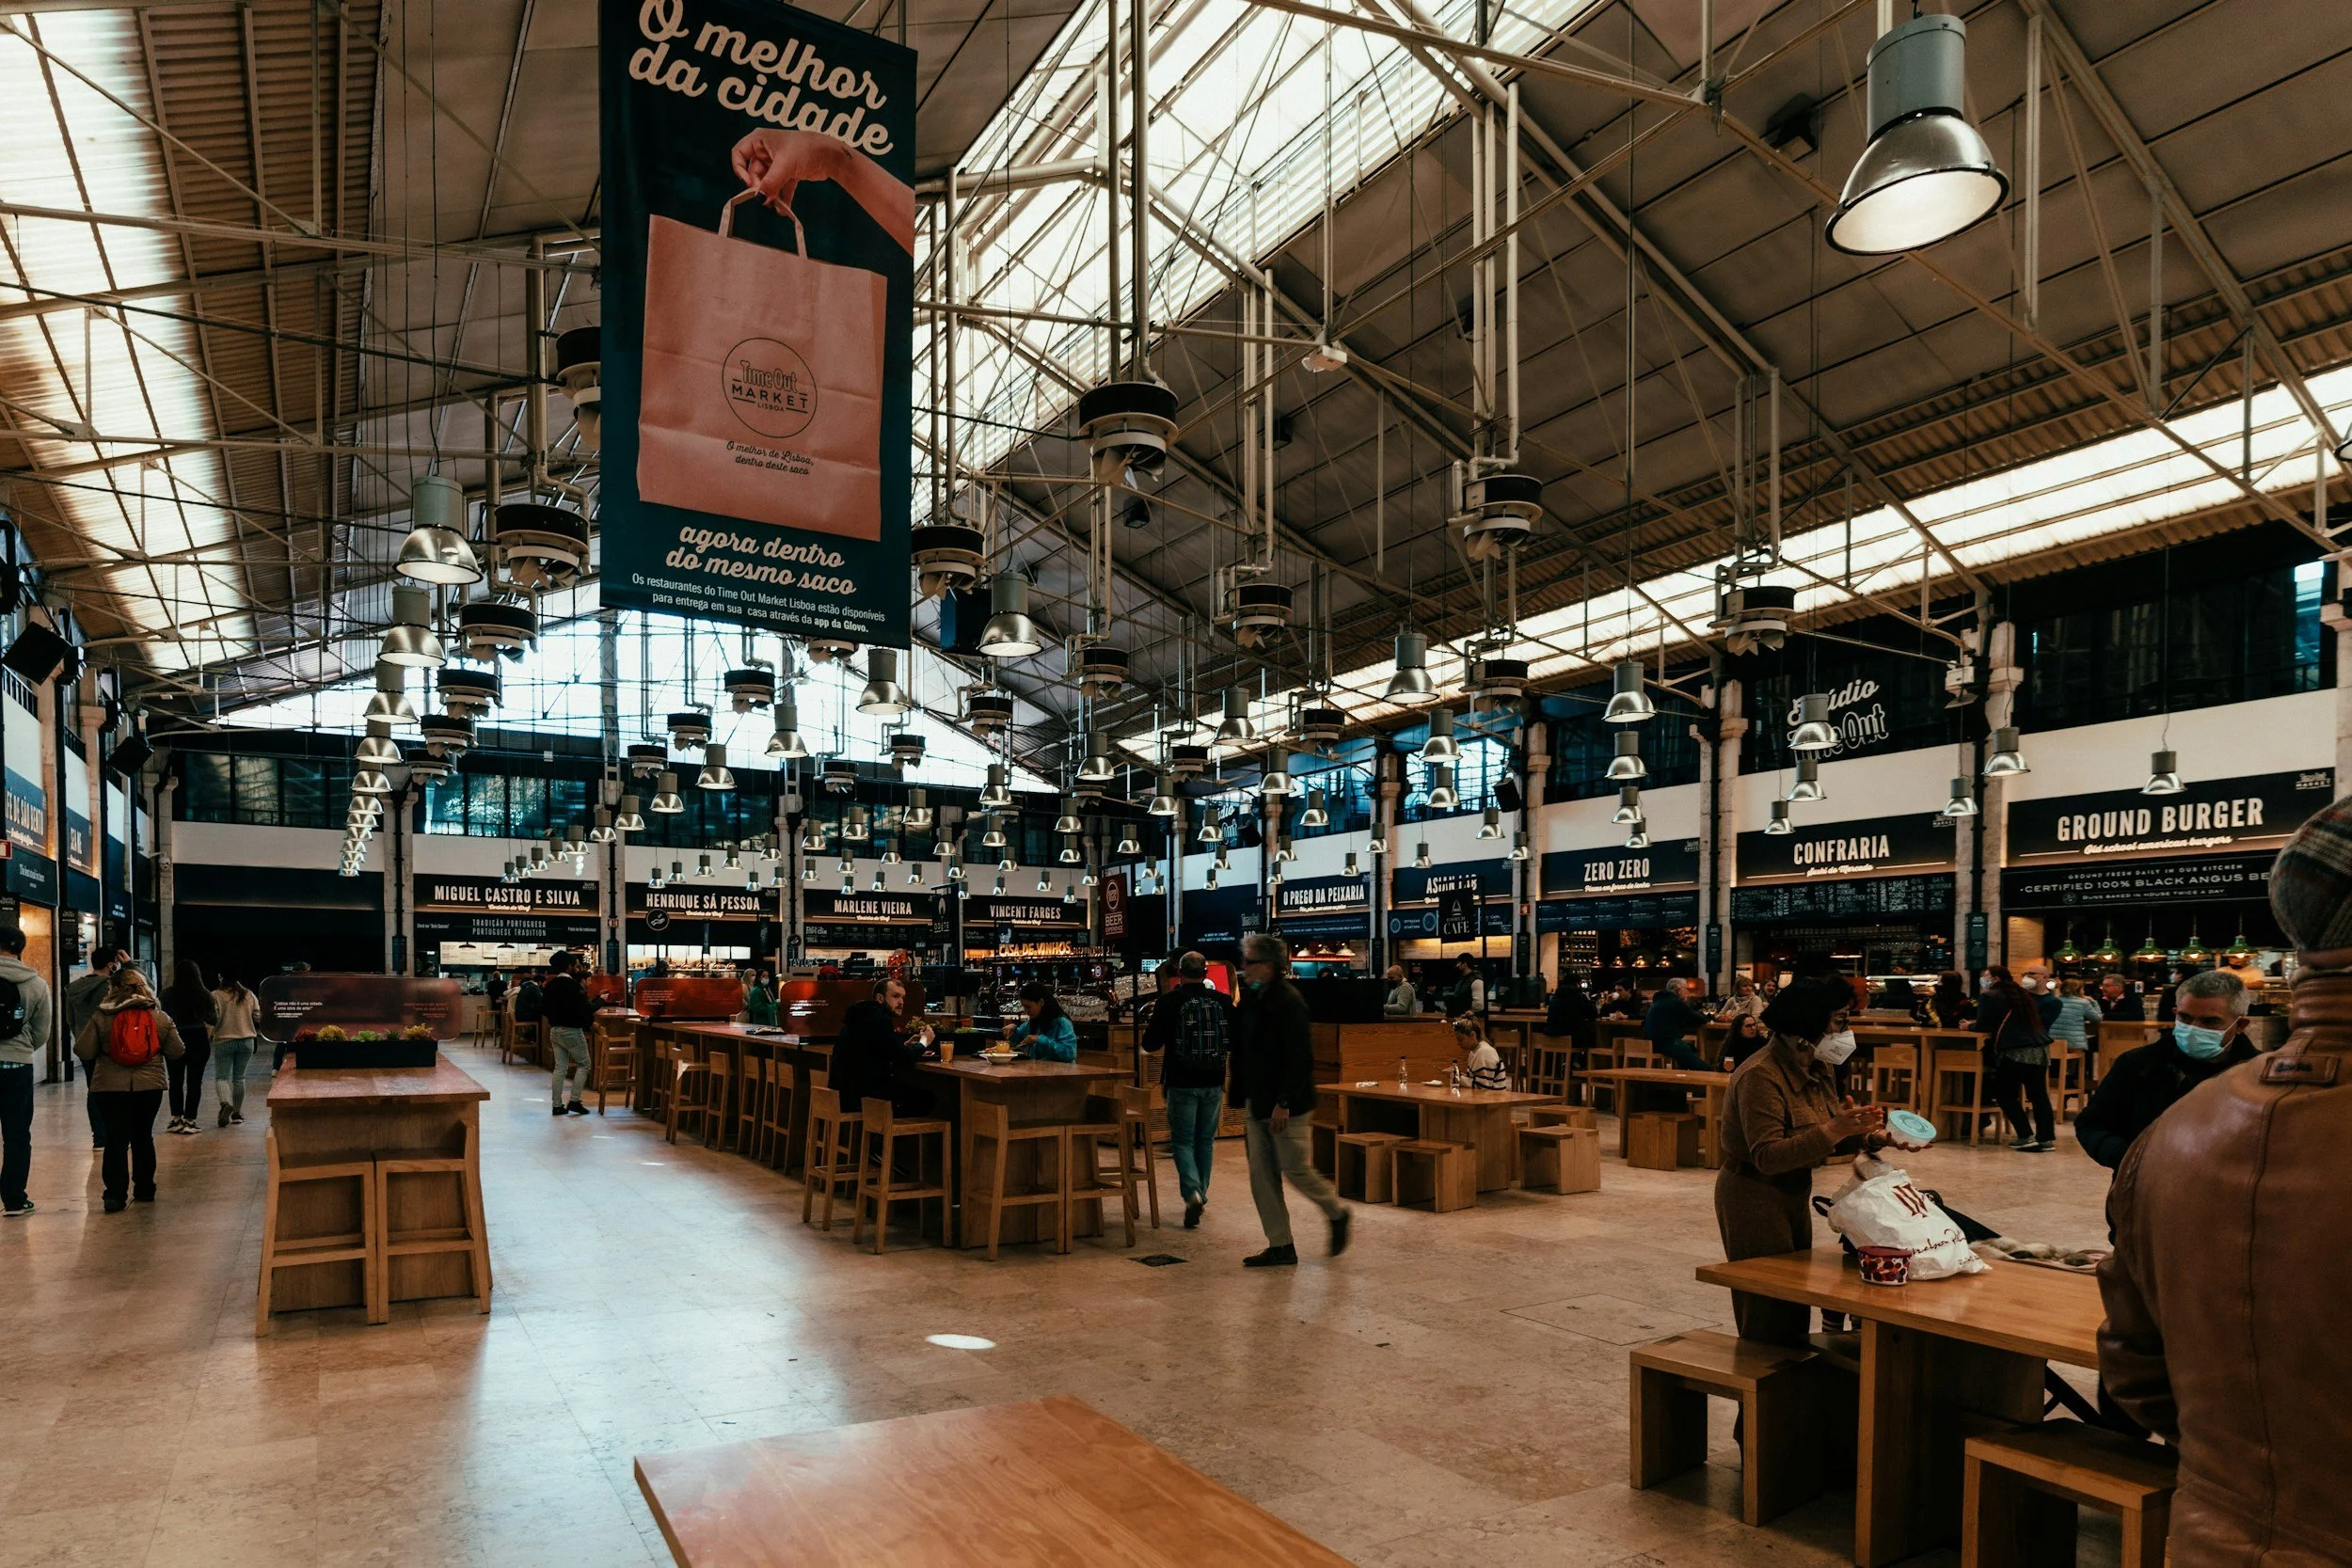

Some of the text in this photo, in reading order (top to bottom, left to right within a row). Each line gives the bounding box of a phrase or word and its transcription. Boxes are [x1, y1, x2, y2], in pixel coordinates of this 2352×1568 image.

[639, 0, 887, 110] O melhor
[628, 42, 894, 156] da cidade
[740, 359, 799, 393] Time Out
[732, 384, 808, 408] MARKET
[756, 403, 786, 413] LISBOA
[726, 440, 814, 467] O melhor de Lisboa,
[736, 454, 810, 476] dentro deste saco
[679, 526, 845, 568] agora dentro
[665, 546, 857, 595] do mesmo saco
[632, 573, 885, 622] Os restaurantes do Time Out Market Lisboa estão disponíveis
[652, 592, 868, 633] para entrega em sua casa através da app da Glovo.
[1787, 679, 1880, 726] Eúdio
[1842, 703, 1889, 750] Out
[2057, 798, 2265, 842] GROUND BURGER
[1793, 834, 1890, 865] CONFRARIA
[2103, 841, 2137, 853] school
[2137, 838, 2188, 851] american
[2188, 835, 2233, 847] burgers
[1583, 857, 1650, 882] ZERO ZERO
[1838, 863, 1874, 875] Mercado
[2068, 871, 2104, 880] GROUND
[2106, 870, 2133, 879] FRESH
[2136, 868, 2160, 877] DAILY
[2178, 866, 2198, 875] OUR
[2202, 863, 2243, 872] KITCHEN
[1283, 883, 1365, 906] O PREGO DA PEIXARIA
[2025, 880, 2092, 894] CERTIFIED
[2097, 879, 2130, 890] 100%
[2135, 876, 2183, 888] BLACK
[2188, 872, 2244, 884] ANGUS
[434, 884, 580, 906] MIGUEL CASTRO E SILVA
[645, 893, 760, 911] HENRIQUE SÁ PESSOA
[834, 899, 913, 915] MARLENE VIEIRA
[989, 904, 1061, 920] VINCENT FARGES
[472, 917, 547, 928] TRADIÇÃO PORTUGUESA
[1104, 913, 1123, 927] BEER
[472, 927, 547, 937] PORTUGUESE TRADITION
[998, 942, 1022, 957] CASA
[1023, 942, 1035, 956] DE
[1036, 941, 1072, 956] VINHOS
